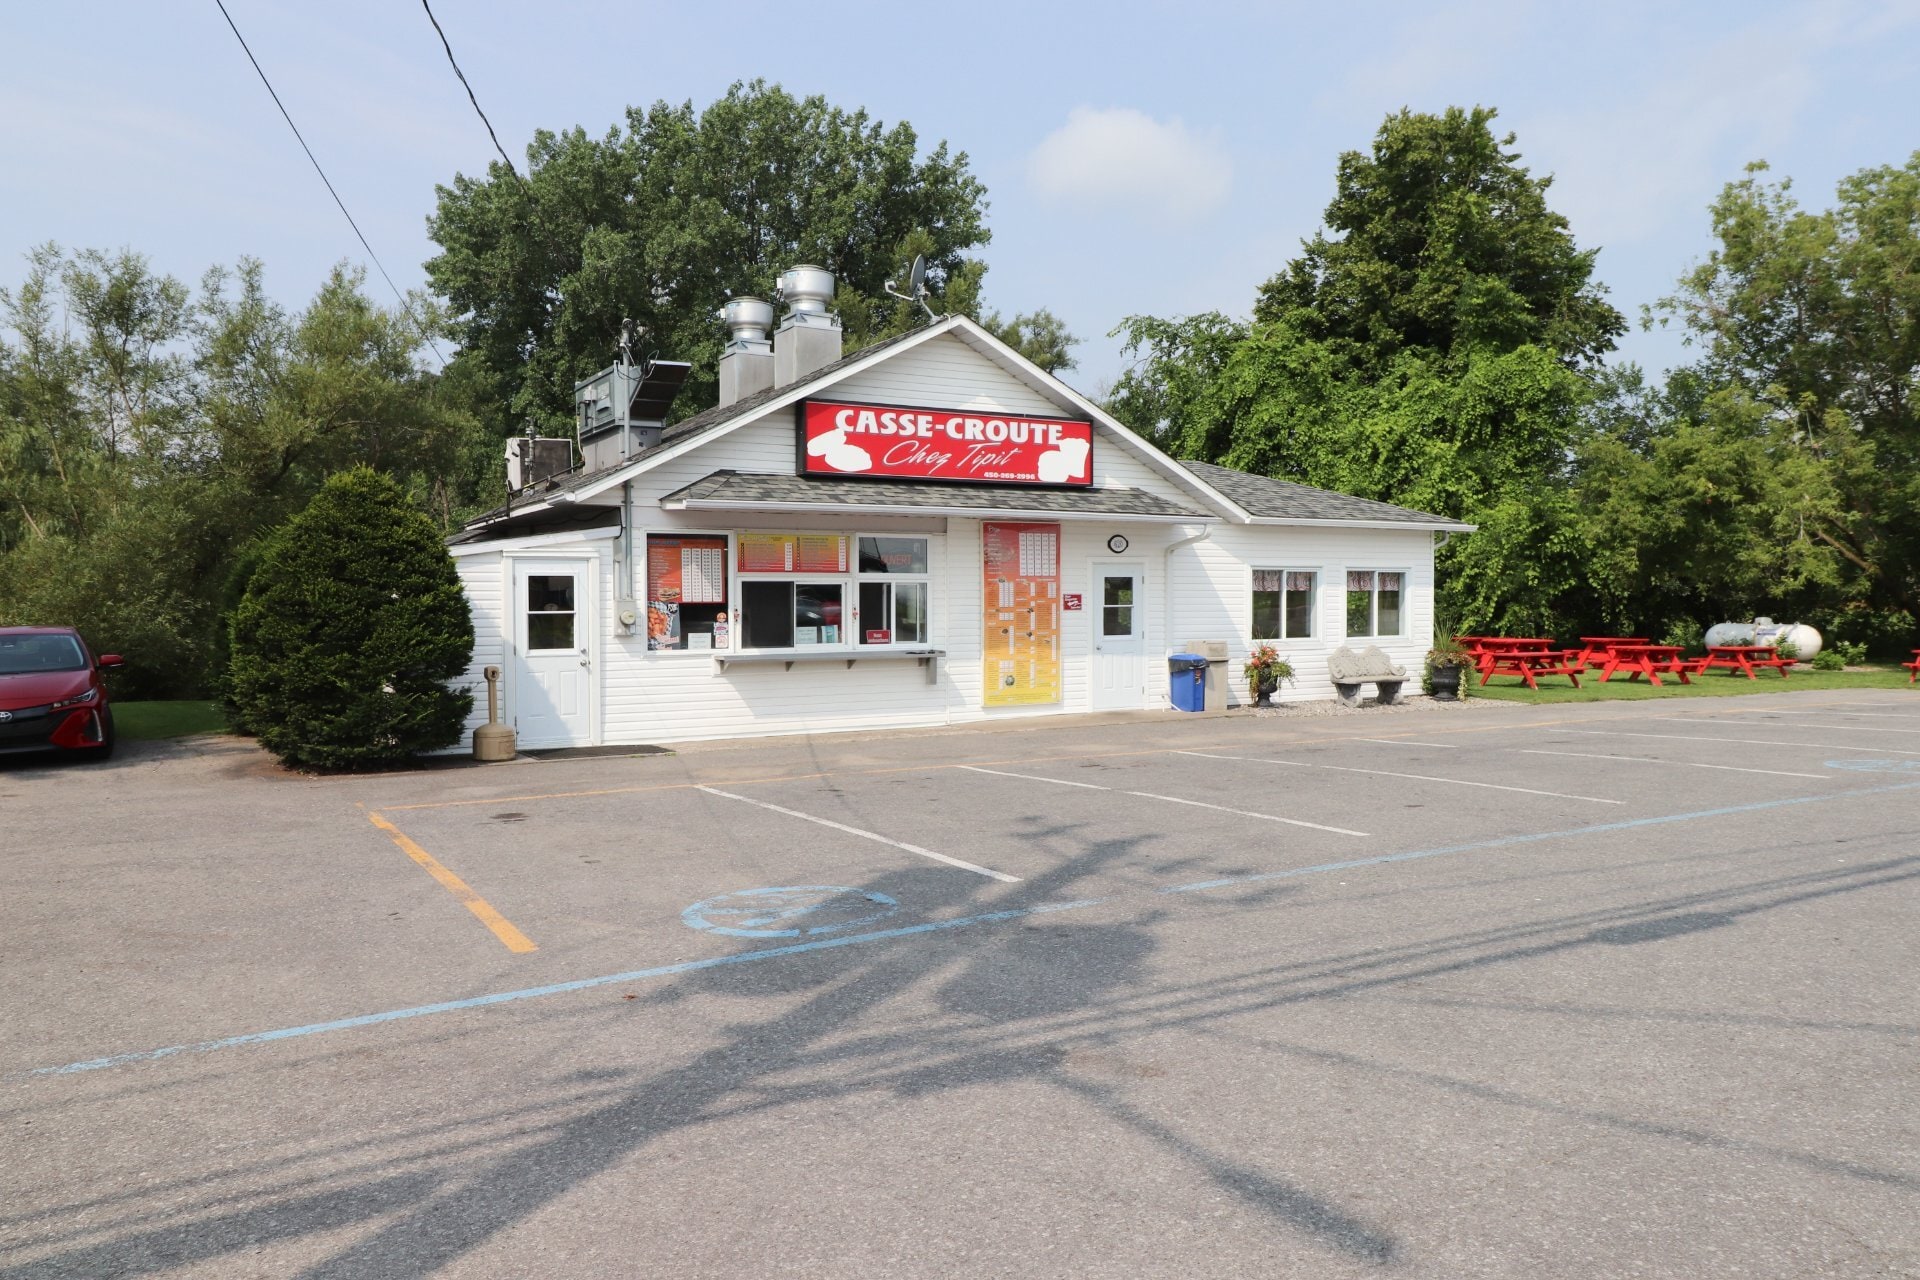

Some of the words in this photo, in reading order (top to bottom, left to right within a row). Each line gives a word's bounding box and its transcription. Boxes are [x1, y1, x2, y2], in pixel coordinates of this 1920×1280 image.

[835, 409, 1063, 445] CASSE-CROUTE
[883, 440, 952, 474] Chez
[957, 442, 1022, 473] Tipit
